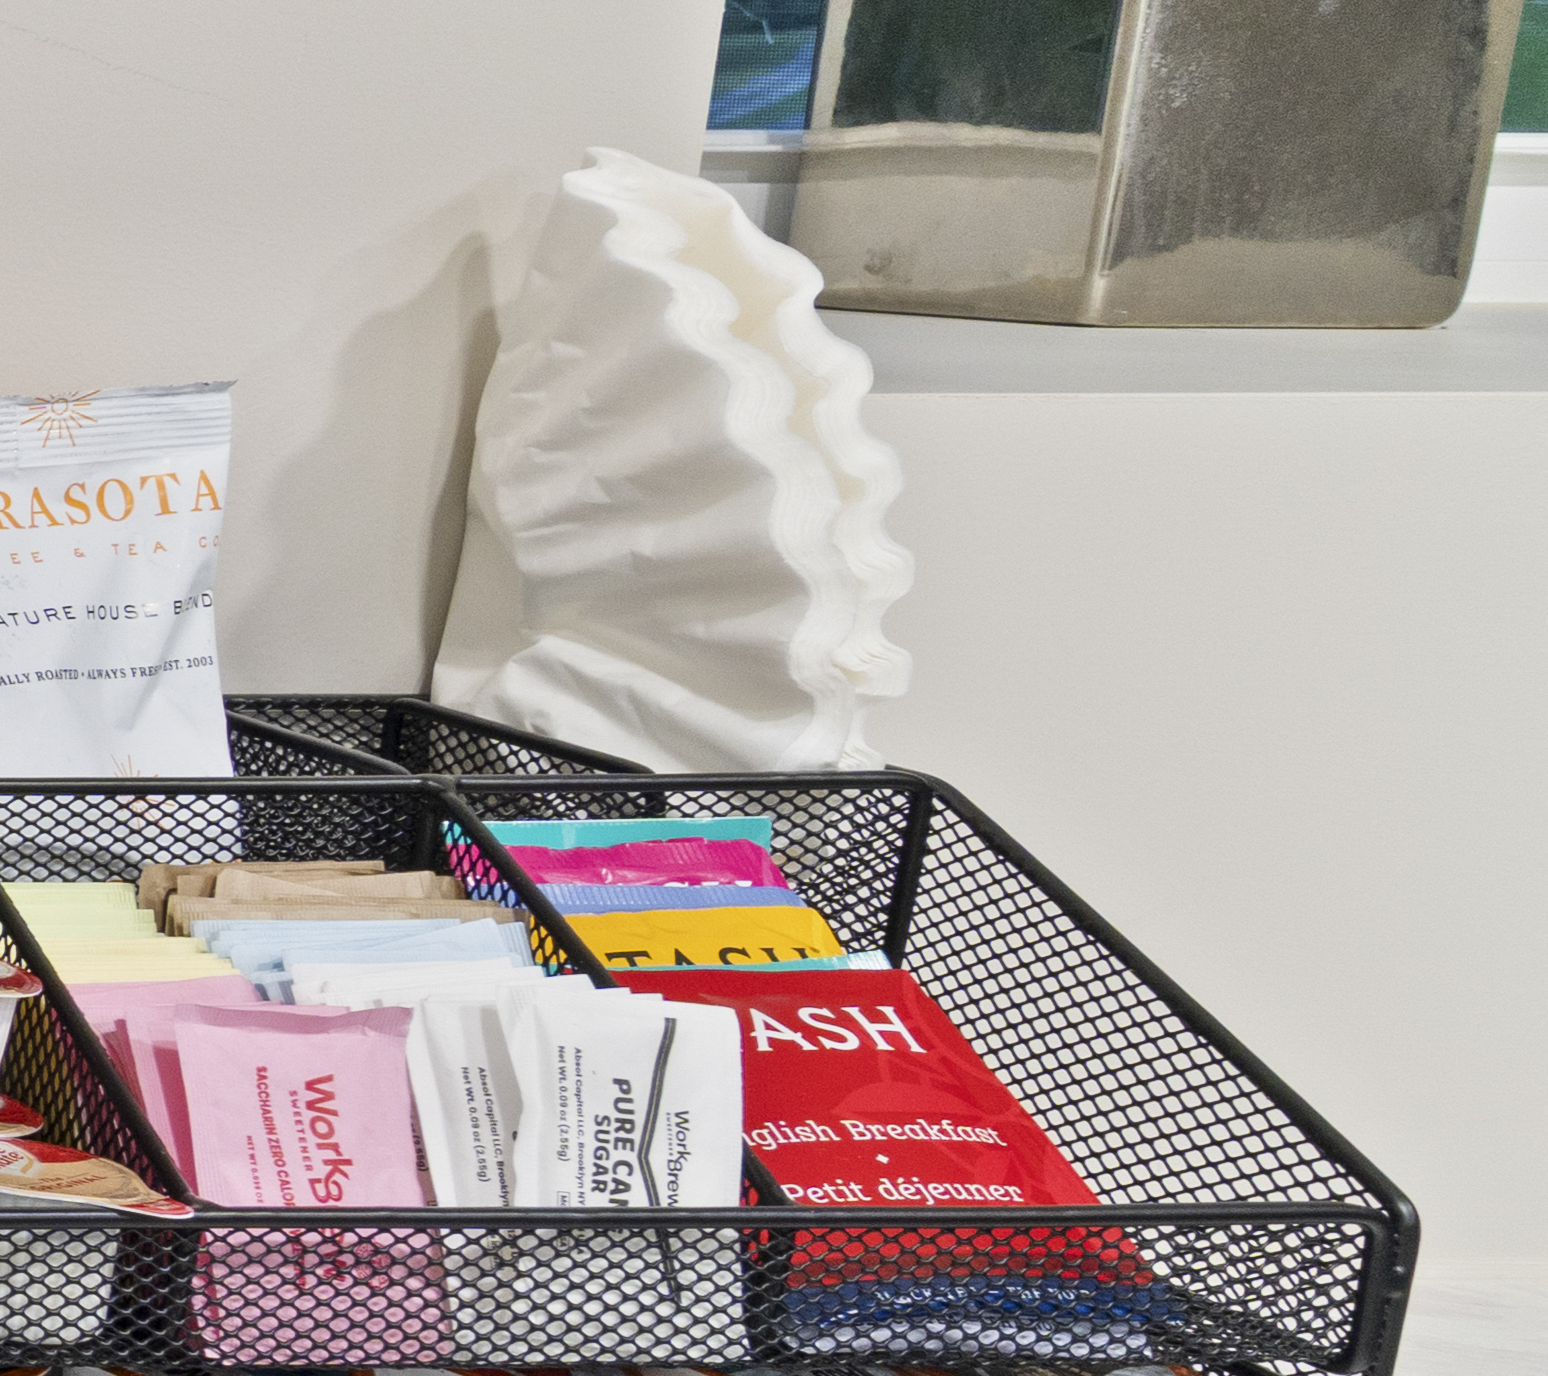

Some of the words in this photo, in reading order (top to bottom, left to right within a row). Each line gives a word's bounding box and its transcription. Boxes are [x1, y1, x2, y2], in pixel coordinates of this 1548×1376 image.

[74, 547, 87, 559] &
[111, 540, 168, 556] TEA
[36, 667, 80, 683] ROASTED
[86, 666, 127, 681] ALWAYS
[186, 654, 215, 669] 2003
[749, 1005, 929, 1054] ASH
[256, 1065, 279, 1135] SACCHARIN
[612, 1077, 636, 1153] PURE
[267, 1137, 287, 1168] ZERO
[288, 1089, 314, 1173] SWEETENER
[484, 1098, 500, 1137] Capital
[496, 1160, 511, 1207] Brooklyn
[591, 1114, 612, 1194] SUGAR
[741, 1119, 840, 1149] nglish
[840, 1119, 1008, 1147] Breakfast
[575, 1142, 586, 1189] Brooklyn
[781, 1182, 863, 1205] Petit
[877, 1178, 1025, 1207] déjeuner
